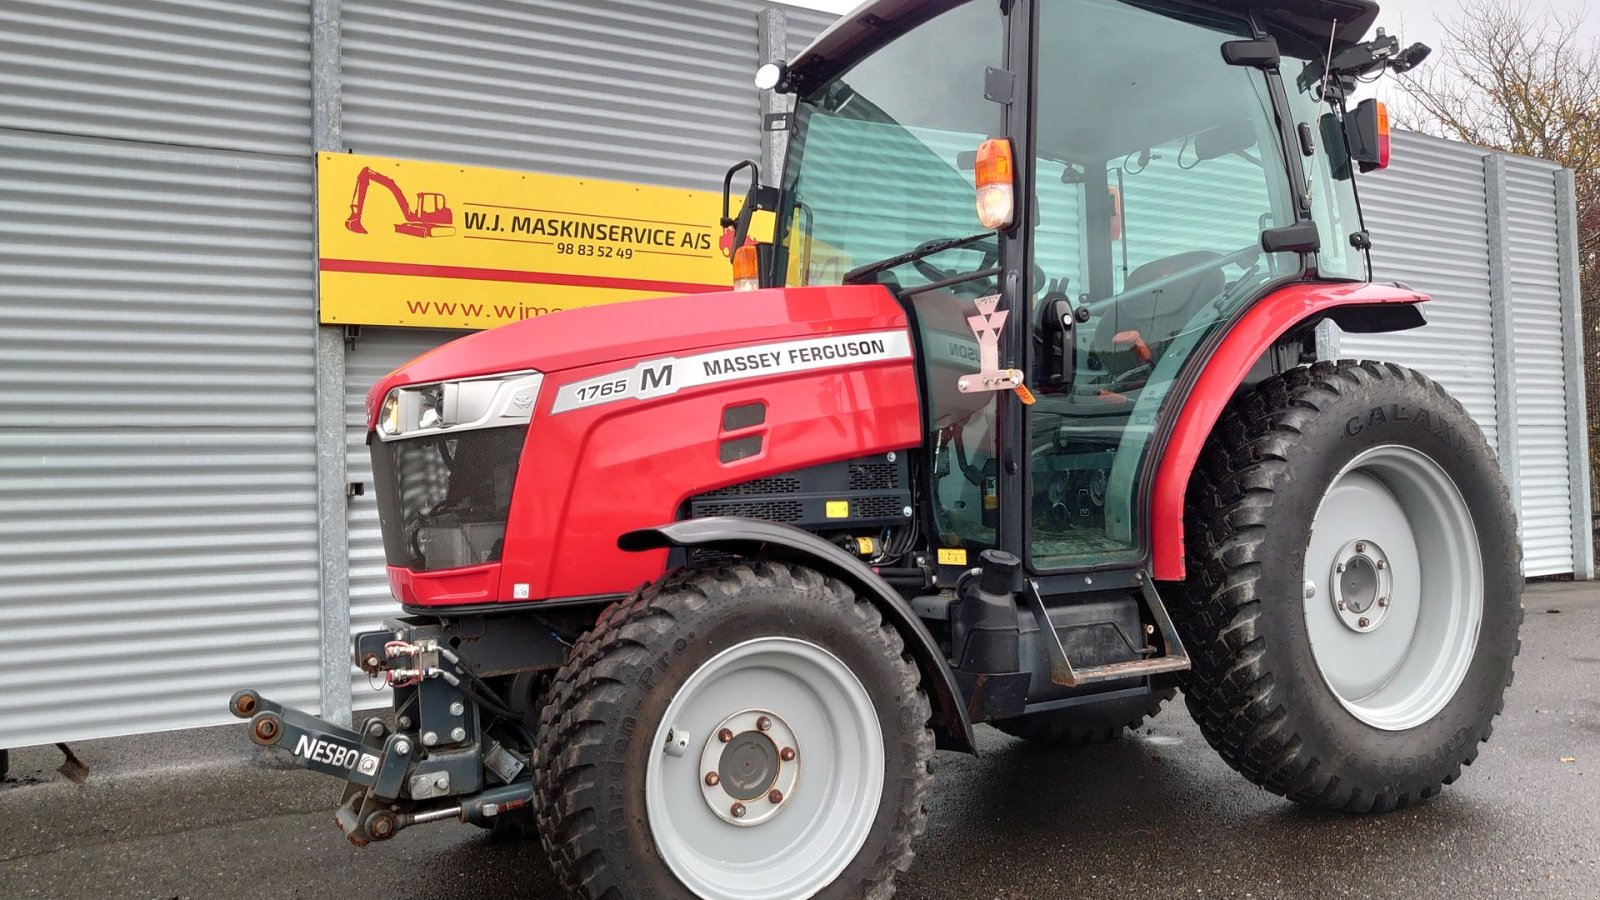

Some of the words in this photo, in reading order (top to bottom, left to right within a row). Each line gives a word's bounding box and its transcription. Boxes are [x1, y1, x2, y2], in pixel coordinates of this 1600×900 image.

[464, 212, 504, 232] W.J.
[511, 216, 676, 247] MASKINSERVICE
[680, 232, 711, 250] A/S
[557, 242, 574, 255] 98
[577, 244, 594, 257] 83
[597, 246, 613, 258] 52
[616, 247, 633, 260] 49
[406, 300, 563, 321] www.wjm
[577, 380, 627, 400] 1765
[640, 364, 673, 391] M
[703, 352, 781, 376] MASSEY
[789, 340, 885, 364] FERGUSON
[294, 734, 359, 769] NESBO
